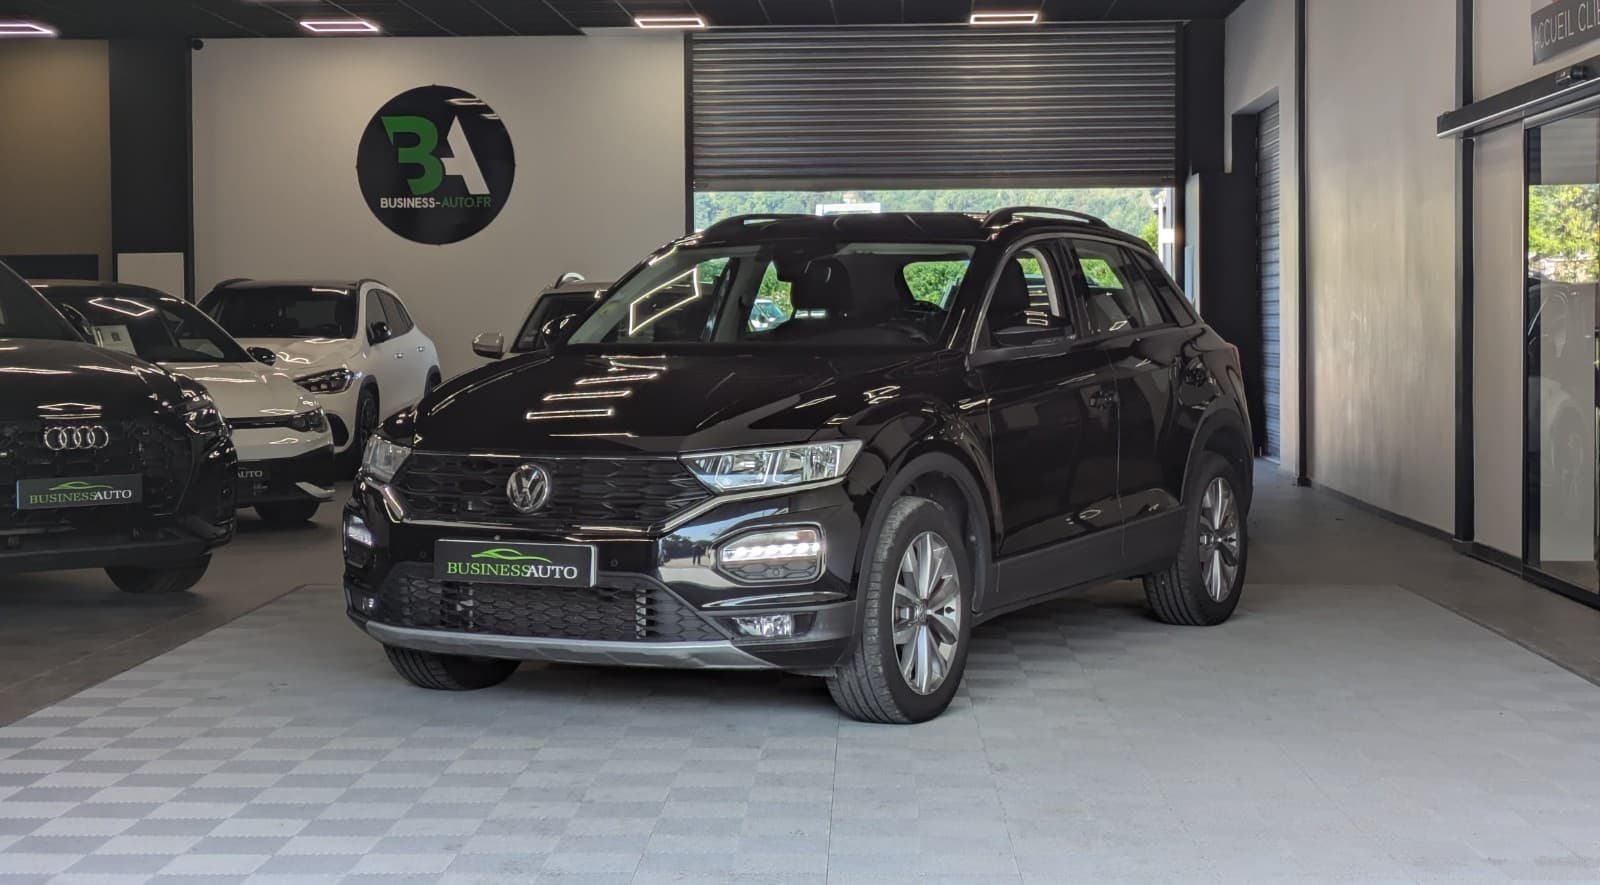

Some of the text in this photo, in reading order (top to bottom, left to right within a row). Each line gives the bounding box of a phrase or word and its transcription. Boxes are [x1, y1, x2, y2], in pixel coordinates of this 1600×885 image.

[1534, 9, 1575, 52] ACCUEIL
[381, 115, 491, 195] BA
[380, 197, 492, 209] BUSINESS-AUTO.FR
